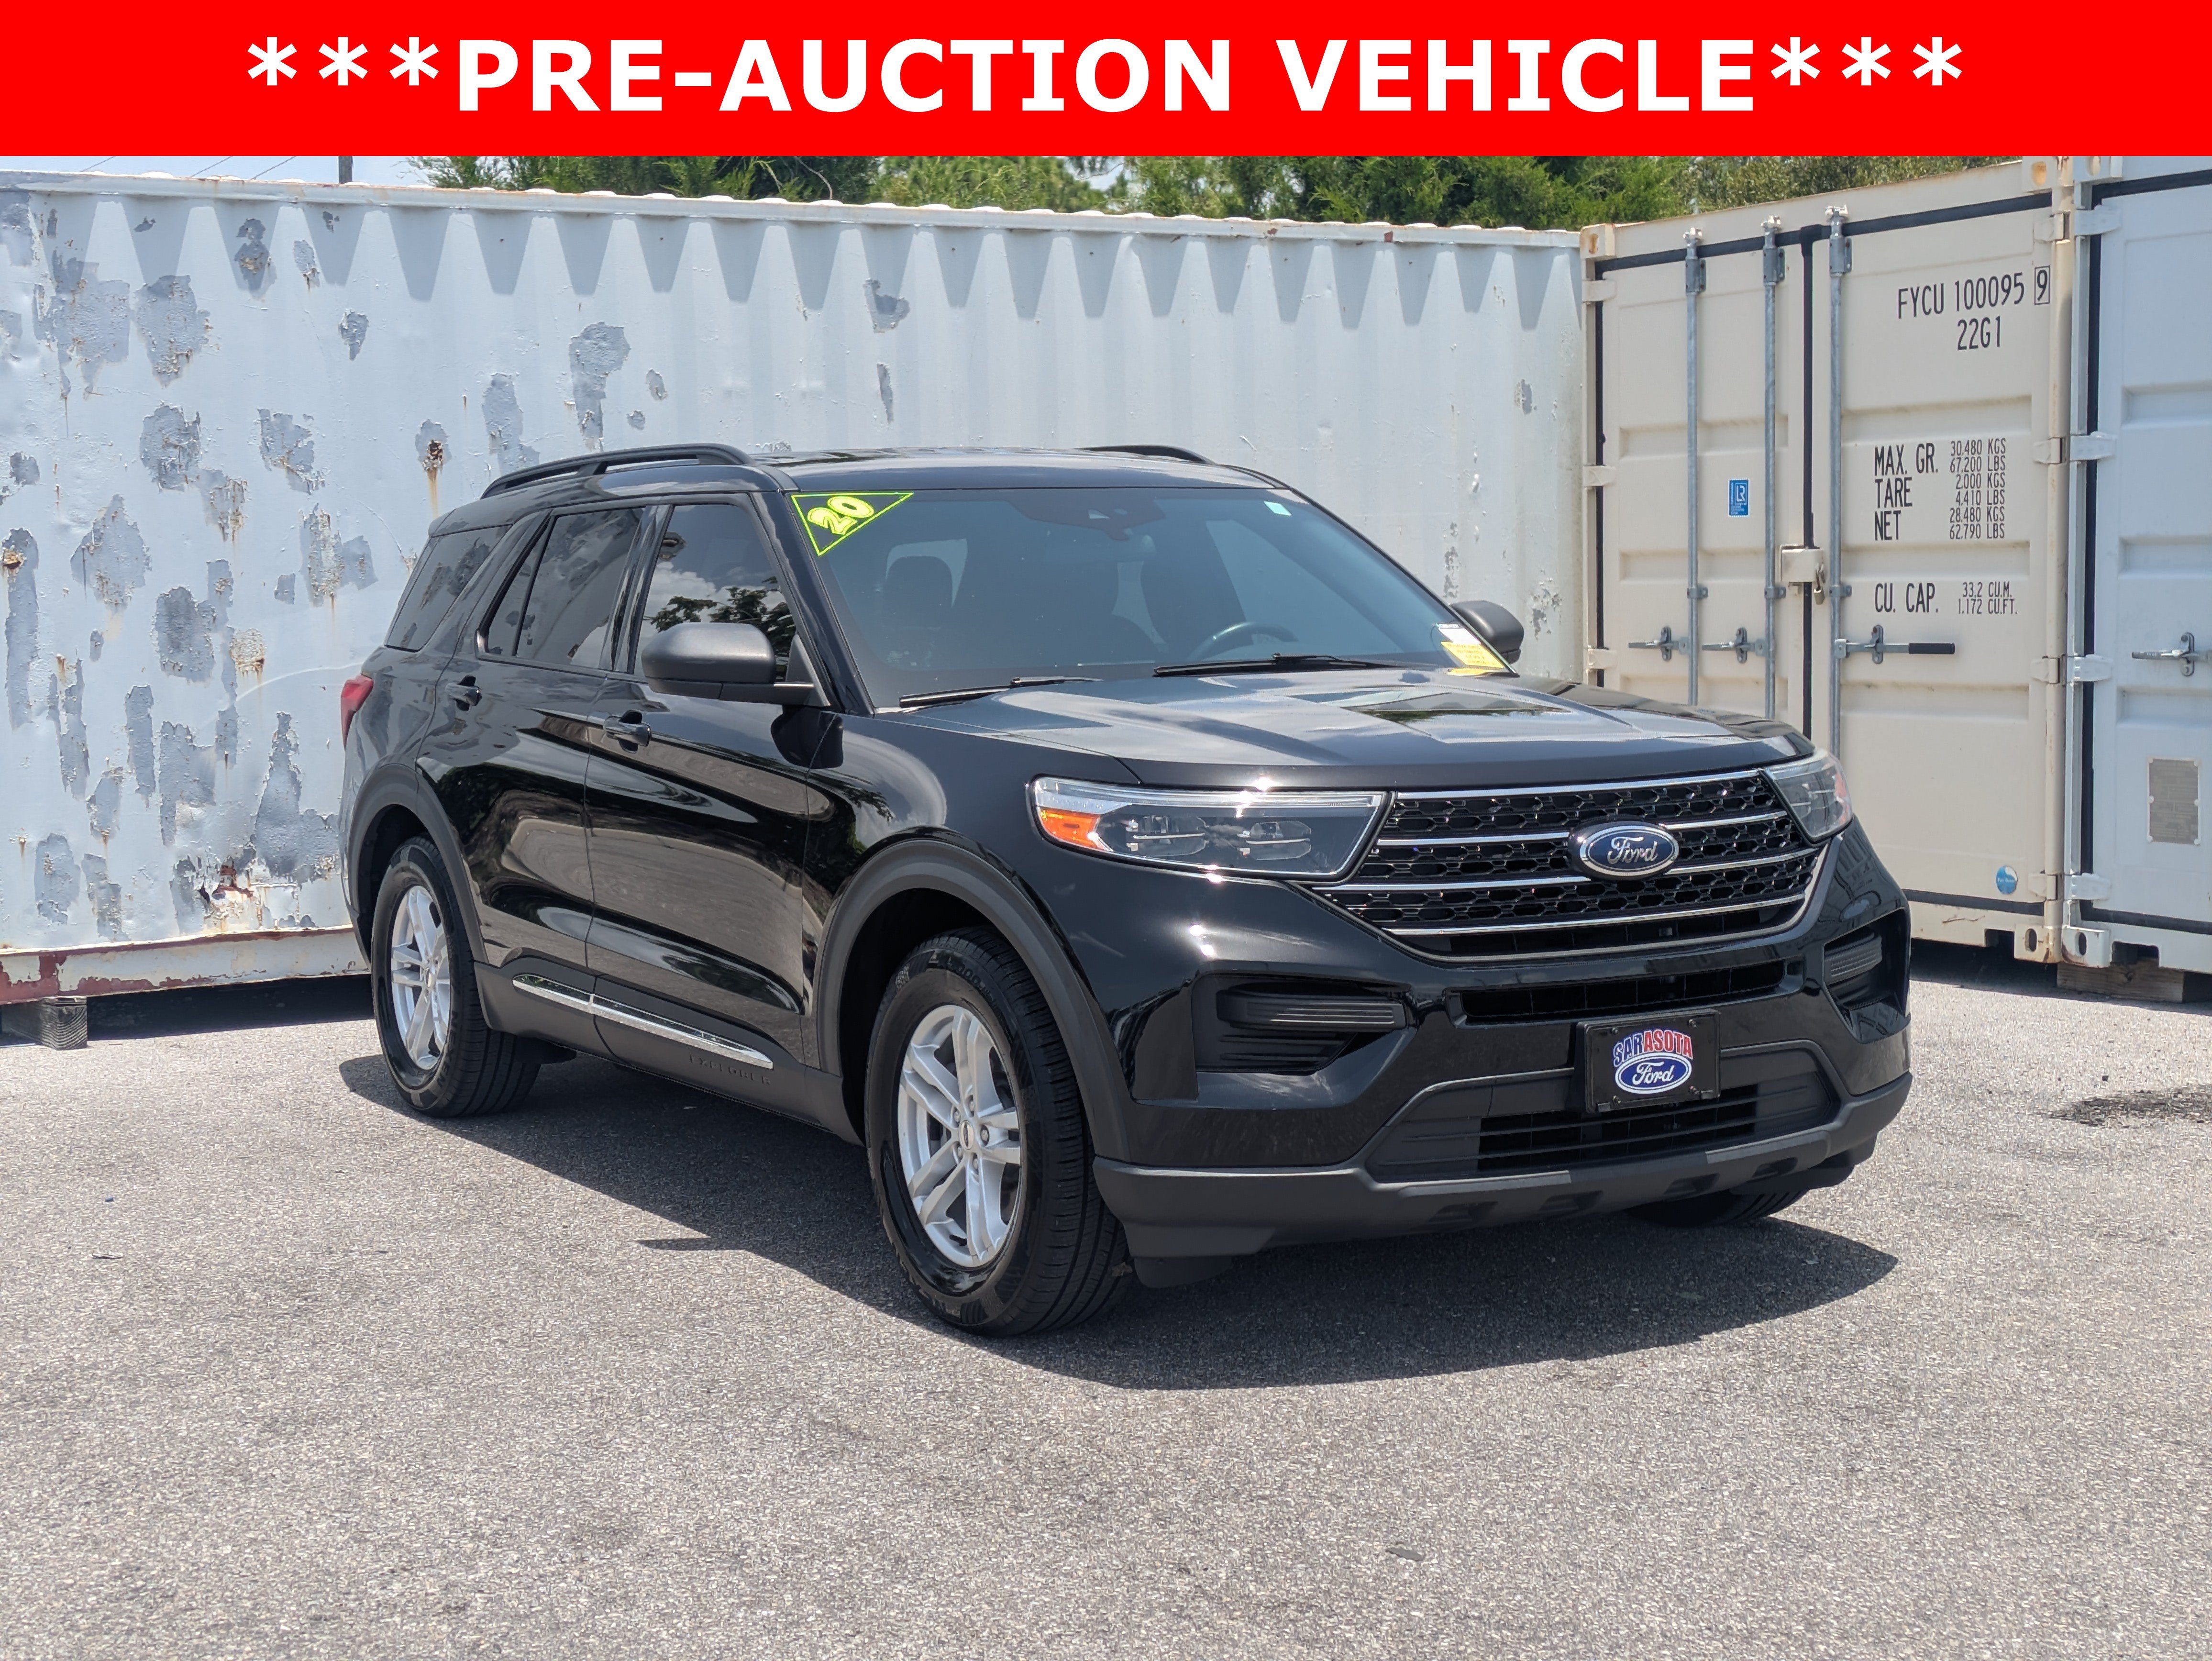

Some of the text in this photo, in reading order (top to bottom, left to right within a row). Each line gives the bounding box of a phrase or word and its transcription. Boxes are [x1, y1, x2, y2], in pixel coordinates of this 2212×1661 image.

[1898, 269, 2048, 319] FYCU 100095 9
[1957, 315, 2001, 351] 22G1
[1874, 443, 1938, 476] MAX. GR.
[1988, 438, 2006, 454] KGS
[1987, 455, 2006, 472] LBS
[1874, 476, 1913, 509] TARE
[1987, 472, 2005, 488] KGS
[1987, 489, 2005, 505] LBS
[807, 496, 874, 535] 20
[1874, 510, 1902, 541] NET
[1986, 506, 2005, 522] KGS
[1986, 522, 2005, 539] LBS
[1875, 582, 1939, 613] CU. CAP.
[1988, 581, 2013, 598] CU.M.
[1607, 836, 1659, 864] Ford
[1613, 1029, 1693, 1068] SARASOTA
[1632, 1061, 1676, 1085] Ford
